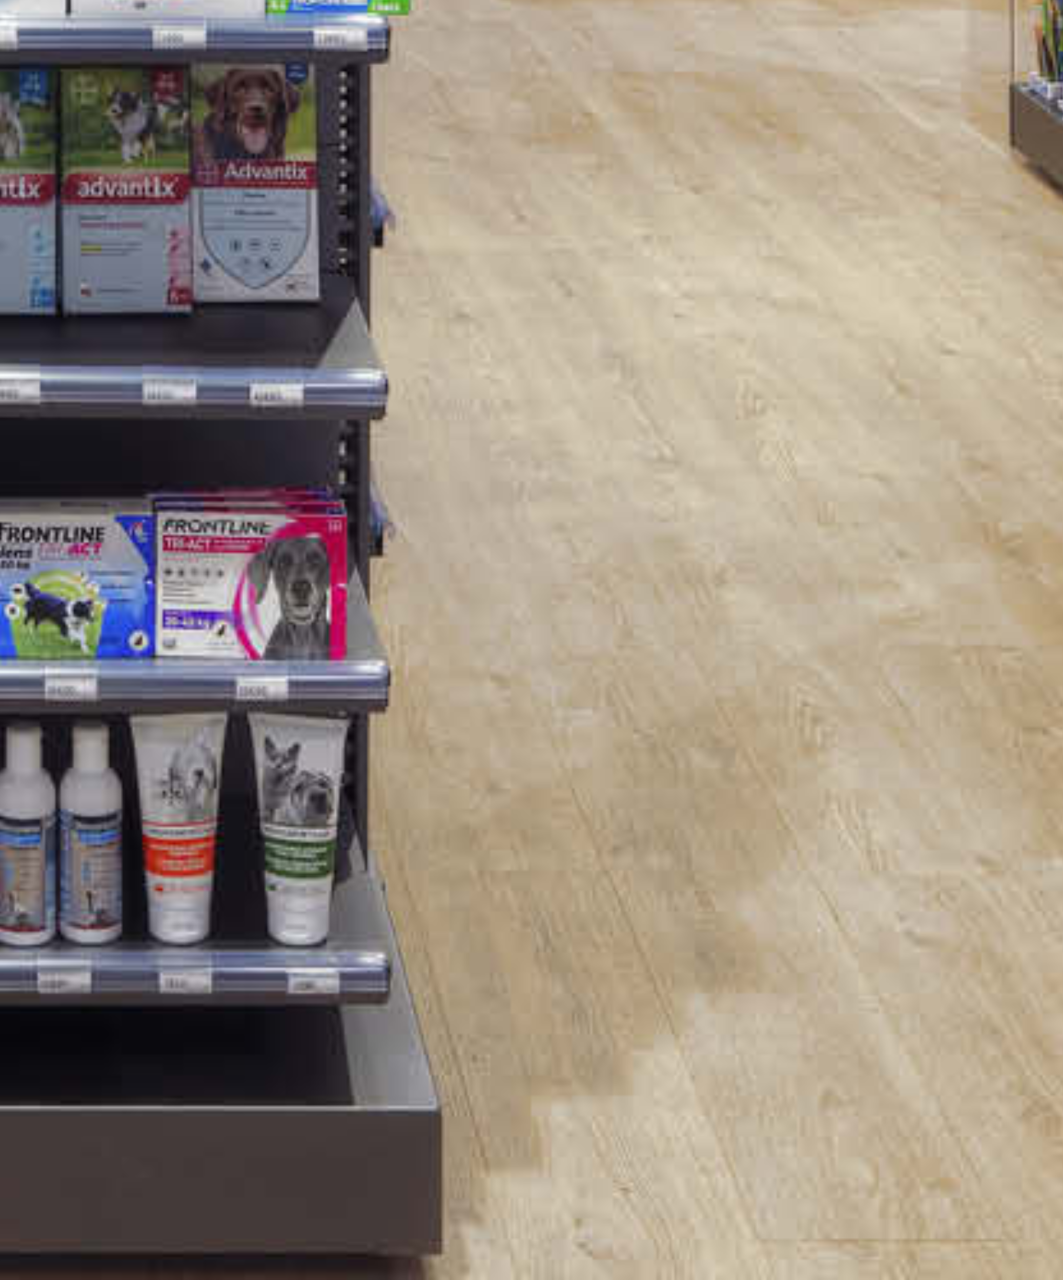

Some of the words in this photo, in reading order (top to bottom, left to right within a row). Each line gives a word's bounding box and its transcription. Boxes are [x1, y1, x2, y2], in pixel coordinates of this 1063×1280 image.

[224, 161, 309, 181] Advantix
[77, 175, 176, 198] advantix
[163, 519, 271, 535] FRONTLINE
